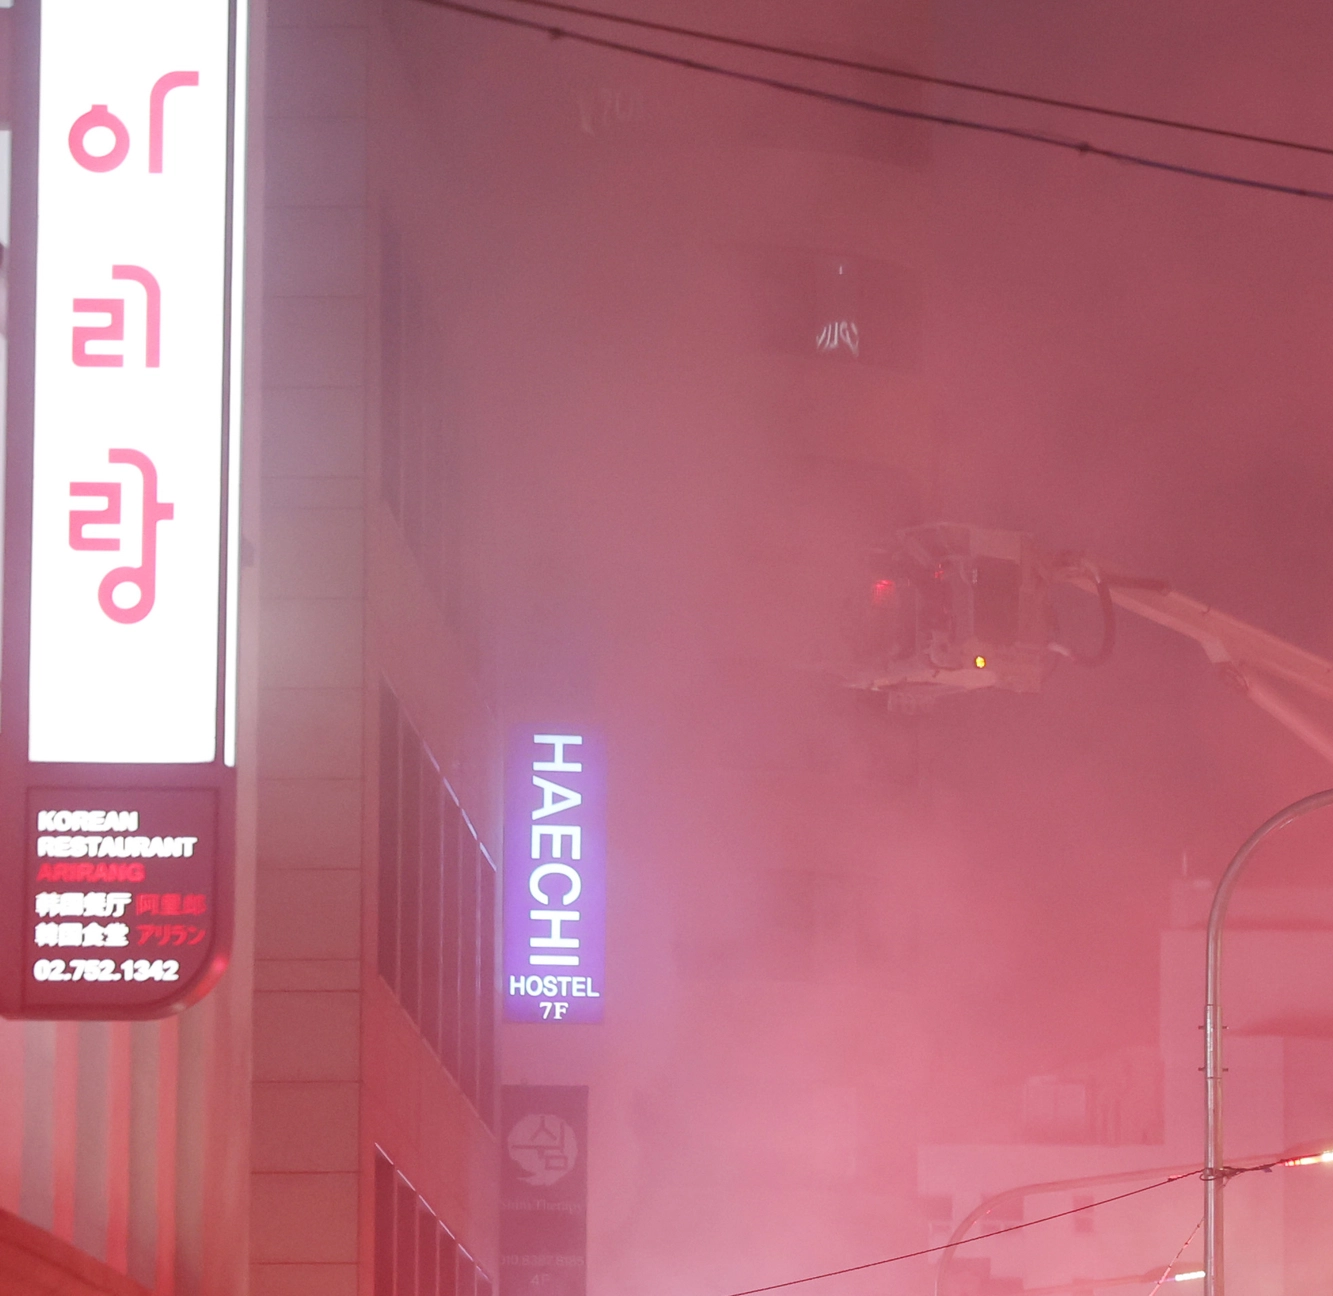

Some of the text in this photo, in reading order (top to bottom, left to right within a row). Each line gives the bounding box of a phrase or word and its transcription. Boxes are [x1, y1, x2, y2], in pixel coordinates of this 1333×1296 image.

[68, 70, 199, 624] 아리랑
[37, 810, 139, 832] KOREAN
[37, 835, 198, 857] RESTAURANT
[529, 733, 583, 967] HAECHI
[36, 861, 146, 883] ARIRANG
[136, 924, 206, 947] アリラン
[33, 958, 180, 982] 02.752.1342
[509, 975, 600, 998] HOSTEL
[539, 1001, 569, 1021] 7F
